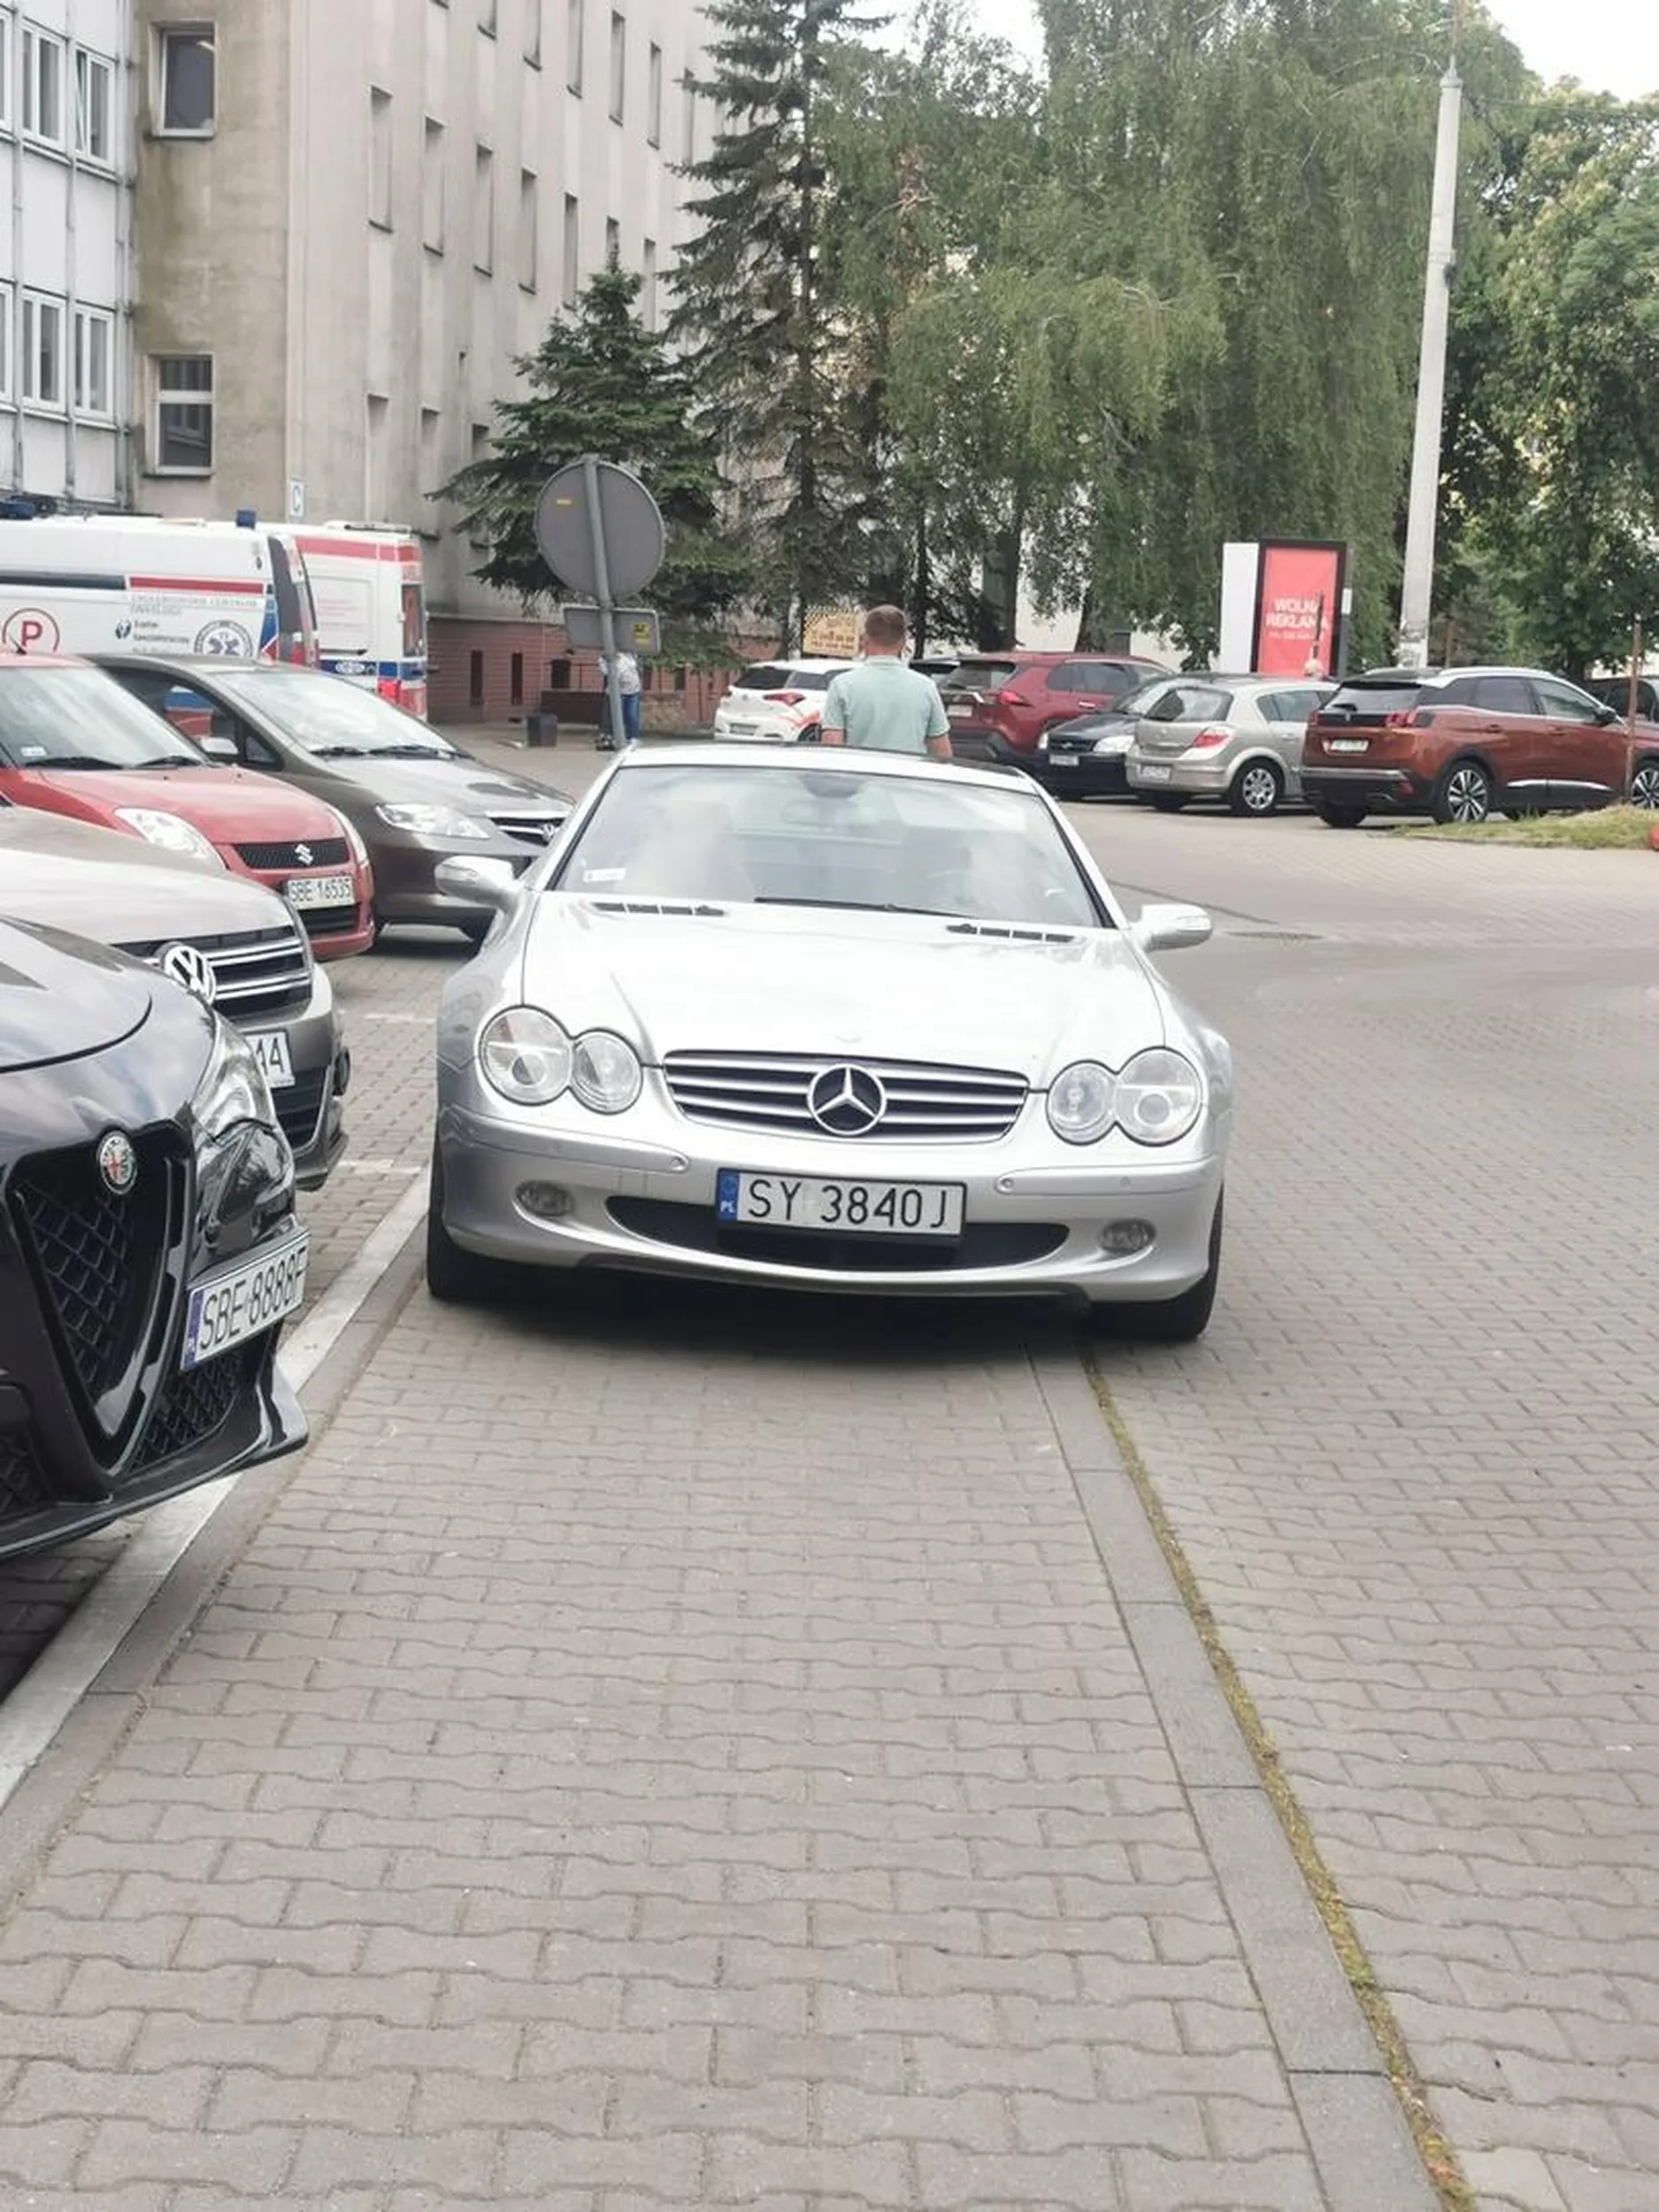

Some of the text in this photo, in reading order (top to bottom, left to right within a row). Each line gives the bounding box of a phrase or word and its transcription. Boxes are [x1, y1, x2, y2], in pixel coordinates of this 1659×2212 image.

[292, 484, 302, 512] C
[21, 620, 43, 647] P
[748, 1179, 948, 1229] SY 3840J
[199, 1245, 307, 1350] SBE 8888F
